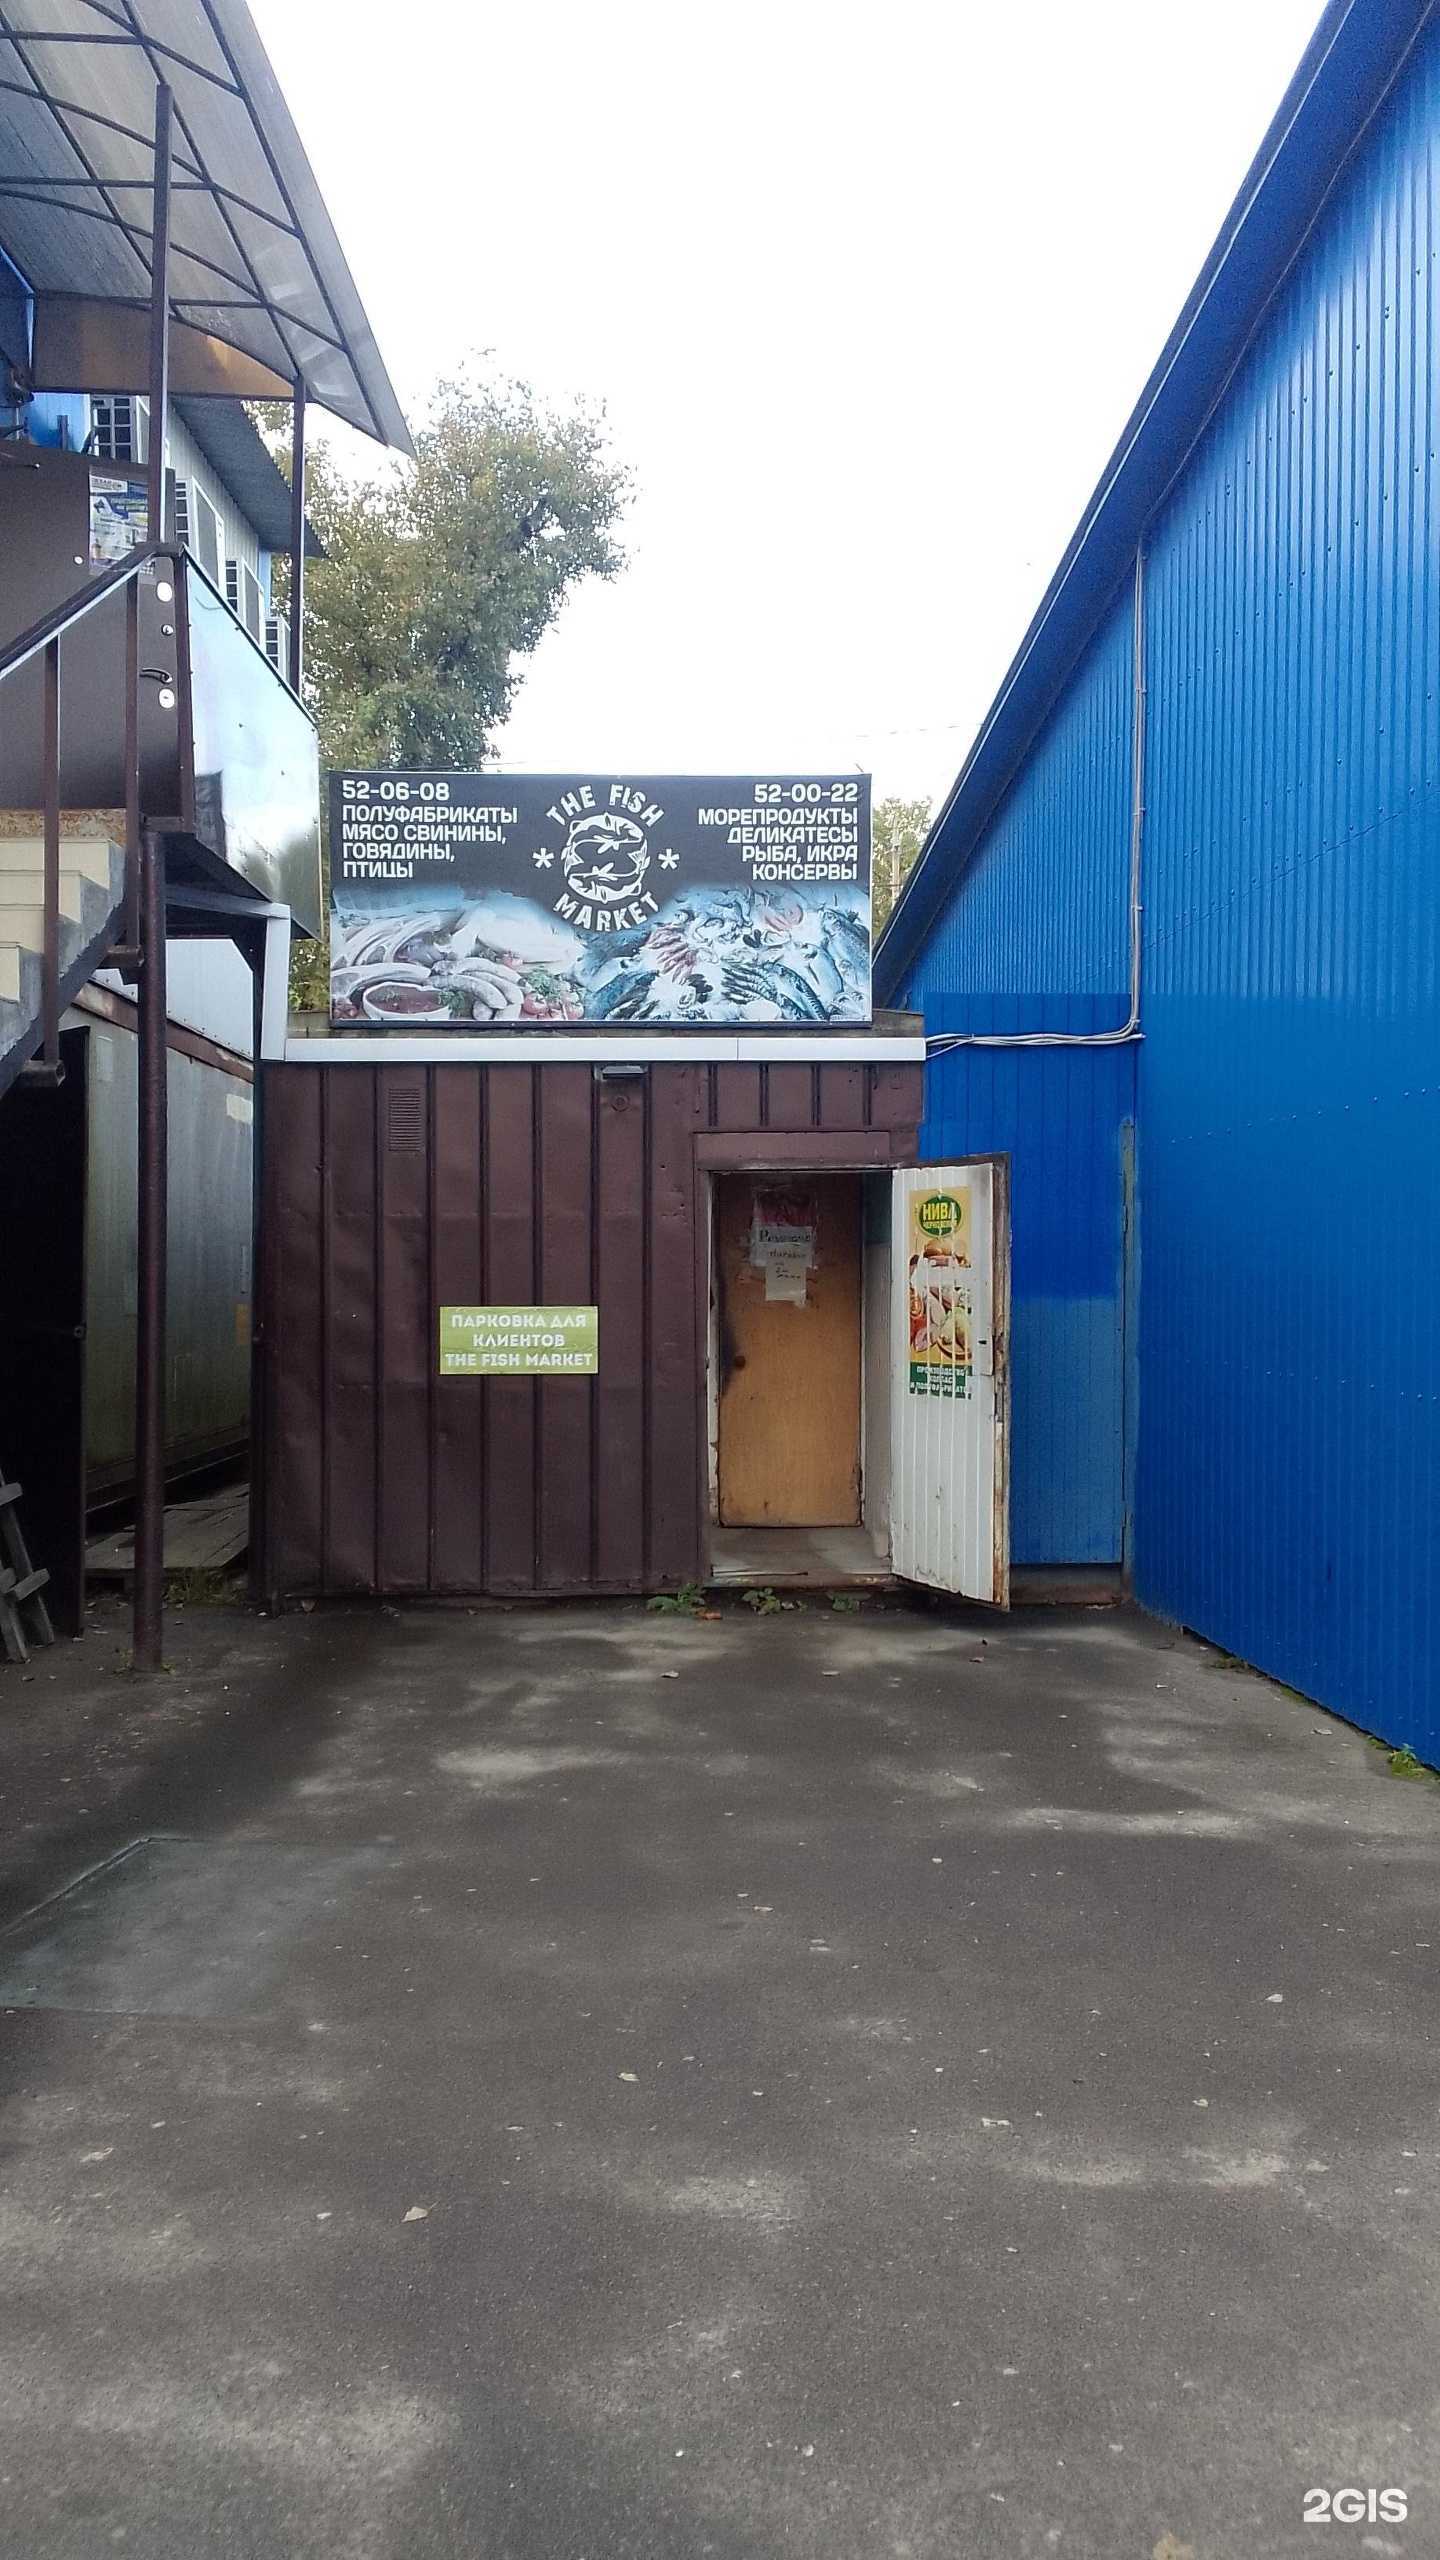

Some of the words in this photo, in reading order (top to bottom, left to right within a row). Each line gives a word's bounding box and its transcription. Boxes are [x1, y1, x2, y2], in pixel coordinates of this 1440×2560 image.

[342, 780, 450, 801] 52-06-08
[754, 783, 858, 803] 52-00-22
[342, 805, 518, 824] ПОЛУФАБРИКАТЫ
[546, 785, 596, 826] THE
[609, 784, 664, 827] FISH
[698, 807, 858, 826] МОРЕПРОДУКТЫ
[342, 824, 399, 841] МЯСО
[403, 825, 507, 845] СВИНИНЫ,
[727, 827, 858, 844] ДЕЛИКАТЕСЫ
[343, 842, 455, 862] ГОВЯДИНЫ,
[742, 845, 801, 864] РЫБА,
[807, 845, 858, 862] ИКРА
[343, 861, 413, 878] ПТИЦЫ
[752, 863, 857, 880] КОНСЕРВЫ
[553, 891, 659, 932] MARKET
[452, 1314, 546, 1328] ПАРКОВКА
[550, 1314, 587, 1328] ДЛЯ
[473, 1334, 565, 1347] КЛИЕНТОВ
[445, 1353, 477, 1366] THE
[481, 1353, 520, 1366] FISH
[525, 1353, 592, 1366] MARKET
